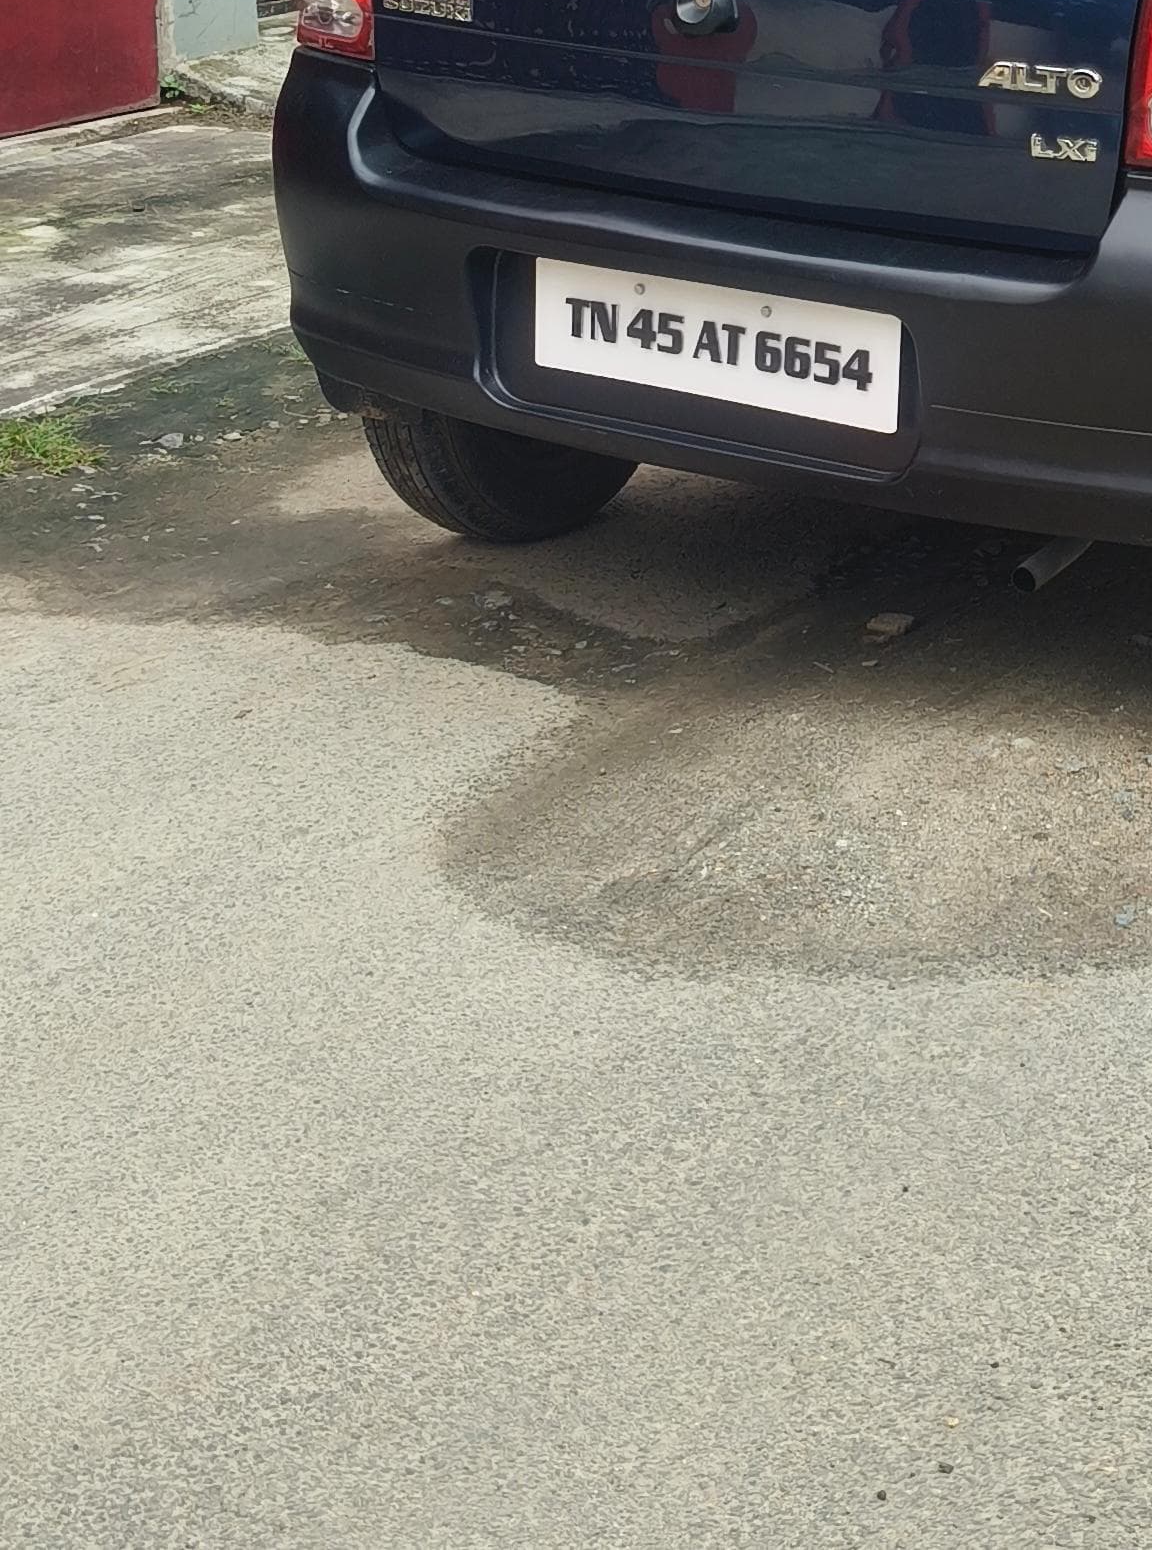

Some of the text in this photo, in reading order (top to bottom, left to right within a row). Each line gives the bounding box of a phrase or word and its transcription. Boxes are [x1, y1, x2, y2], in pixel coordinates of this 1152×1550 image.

[978, 61, 1102, 99] ALTO
[565, 297, 873, 392] TN 45 AT 6654
